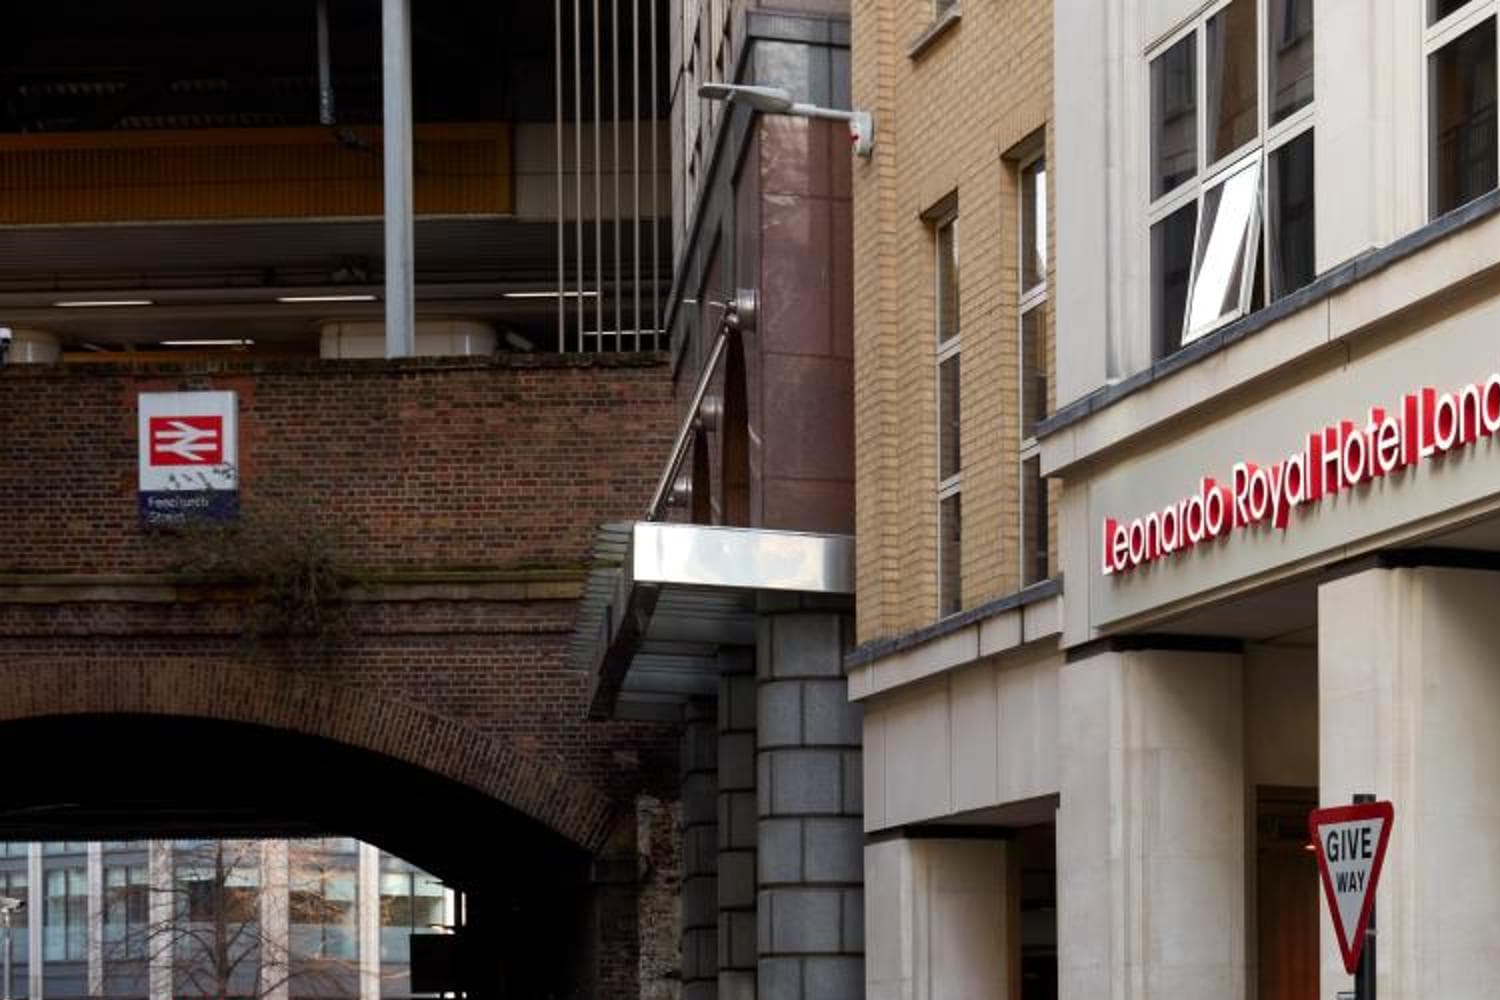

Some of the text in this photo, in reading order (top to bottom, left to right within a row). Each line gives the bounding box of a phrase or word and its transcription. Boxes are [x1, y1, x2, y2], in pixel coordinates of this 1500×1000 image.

[1102, 475, 1232, 575] Leonardo
[1231, 434, 1319, 528] Royal
[1319, 394, 1417, 495] Hotel
[1326, 827, 1373, 863] GIVE
[1335, 870, 1367, 893] WAY
